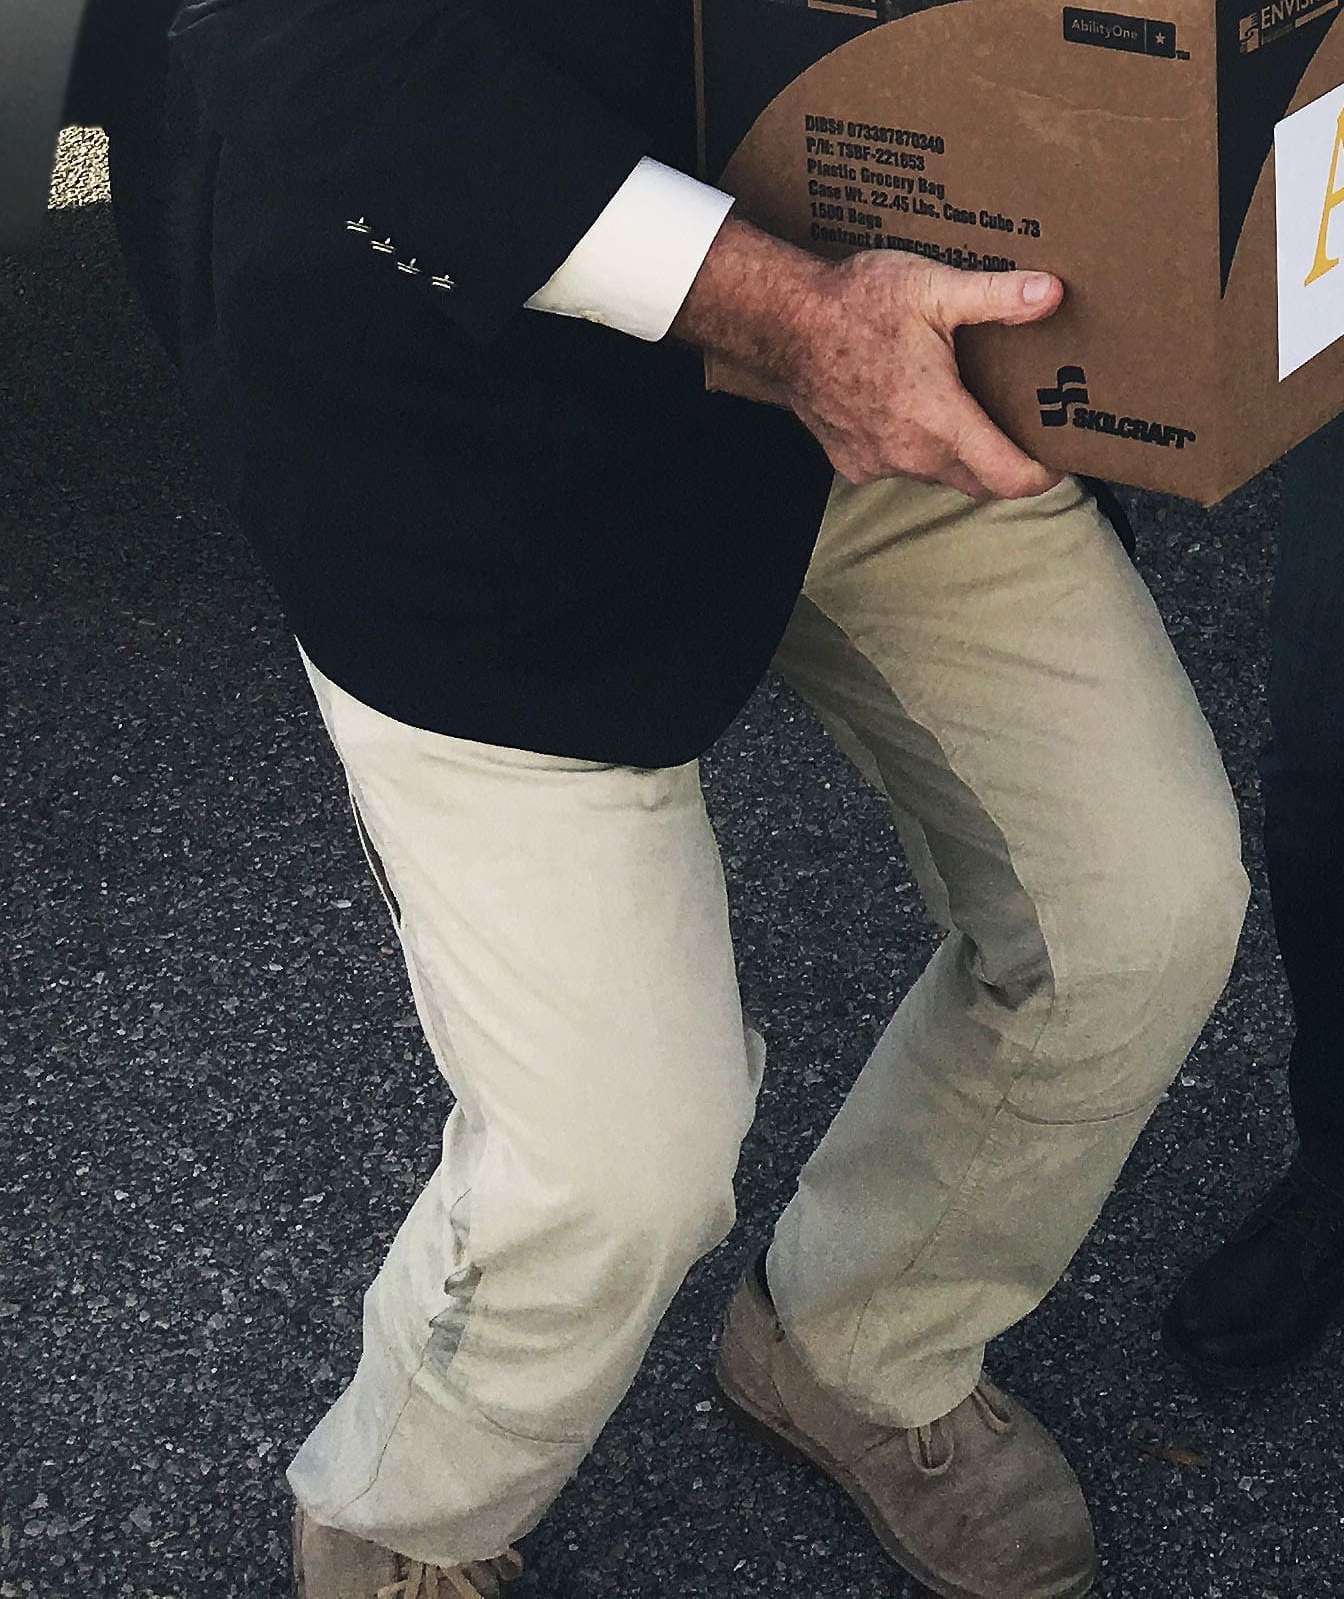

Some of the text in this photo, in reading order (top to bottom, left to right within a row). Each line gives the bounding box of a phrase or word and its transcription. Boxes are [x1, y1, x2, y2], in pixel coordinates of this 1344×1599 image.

[1071, 19, 1138, 39] AbilityOne
[807, 157, 945, 201] Plastic Grocery Bag
[808, 179, 842, 200] Case
[844, 186, 868, 204] Wt.
[870, 190, 909, 213] 22.45
[943, 202, 977, 225] Case
[979, 209, 1014, 233] Cube
[810, 201, 882, 230] 1500 Bags
[1073, 407, 1192, 449] SKILCRAFT
